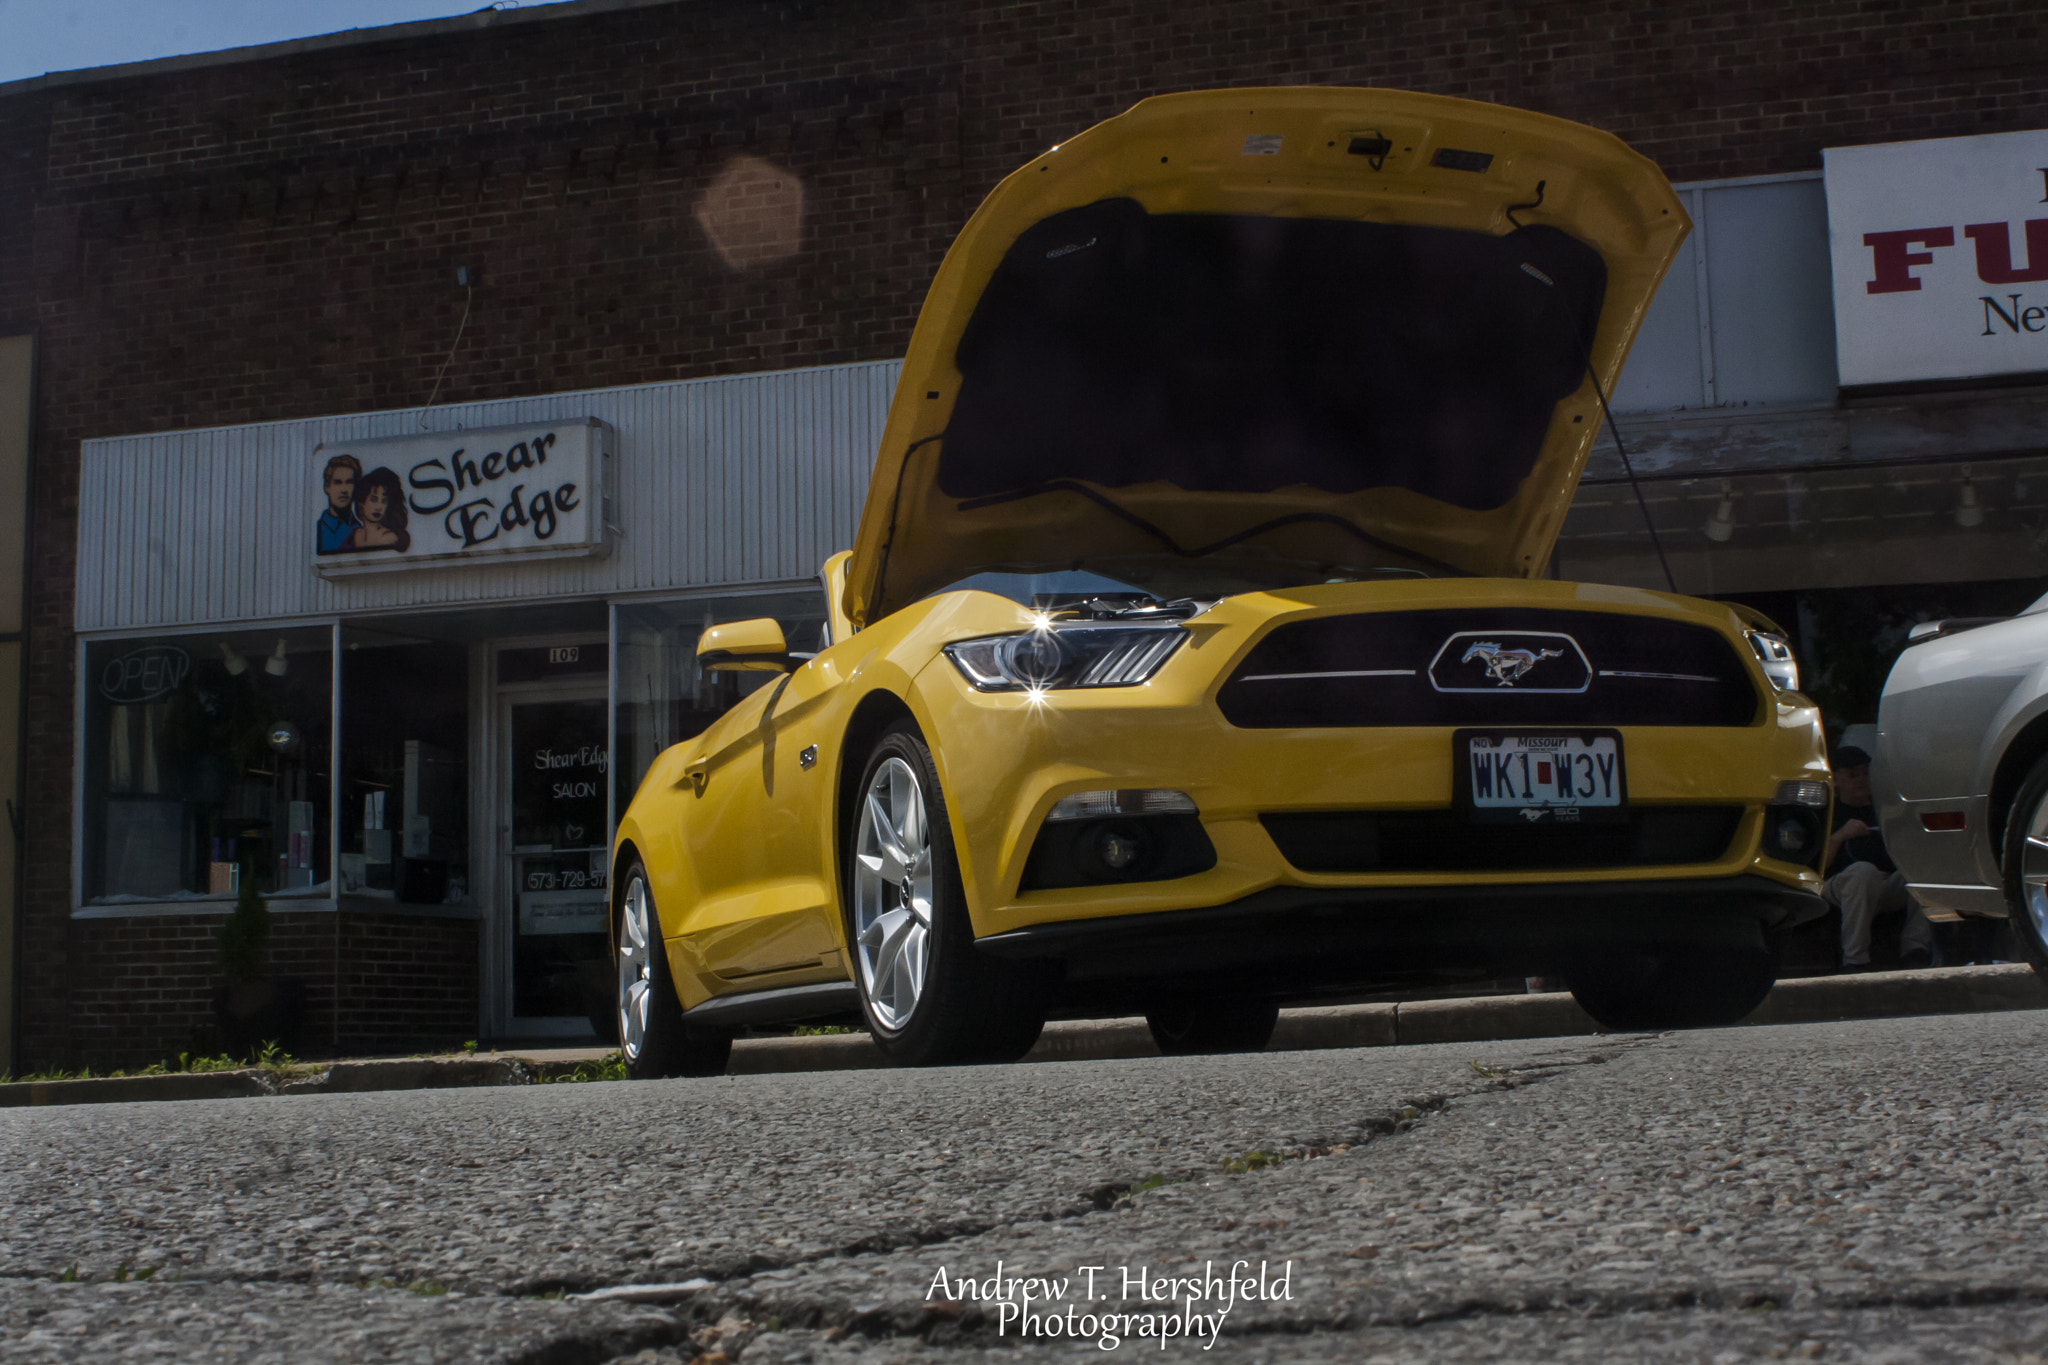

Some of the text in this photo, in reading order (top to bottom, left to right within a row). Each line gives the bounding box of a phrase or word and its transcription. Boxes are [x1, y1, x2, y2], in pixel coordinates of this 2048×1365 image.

[1978, 294, 2048, 336] Ne
[408, 432, 556, 515] Shear
[445, 483, 580, 549] Edge
[552, 648, 578, 662] 109
[103, 656, 182, 693] OPEN
[1517, 737, 1568, 748] Missouri
[535, 748, 578, 770] Shear
[1473, 752, 1614, 798] WK1 W3Y
[553, 781, 596, 799] SALON
[528, 870, 608, 889] (573)-729-57
